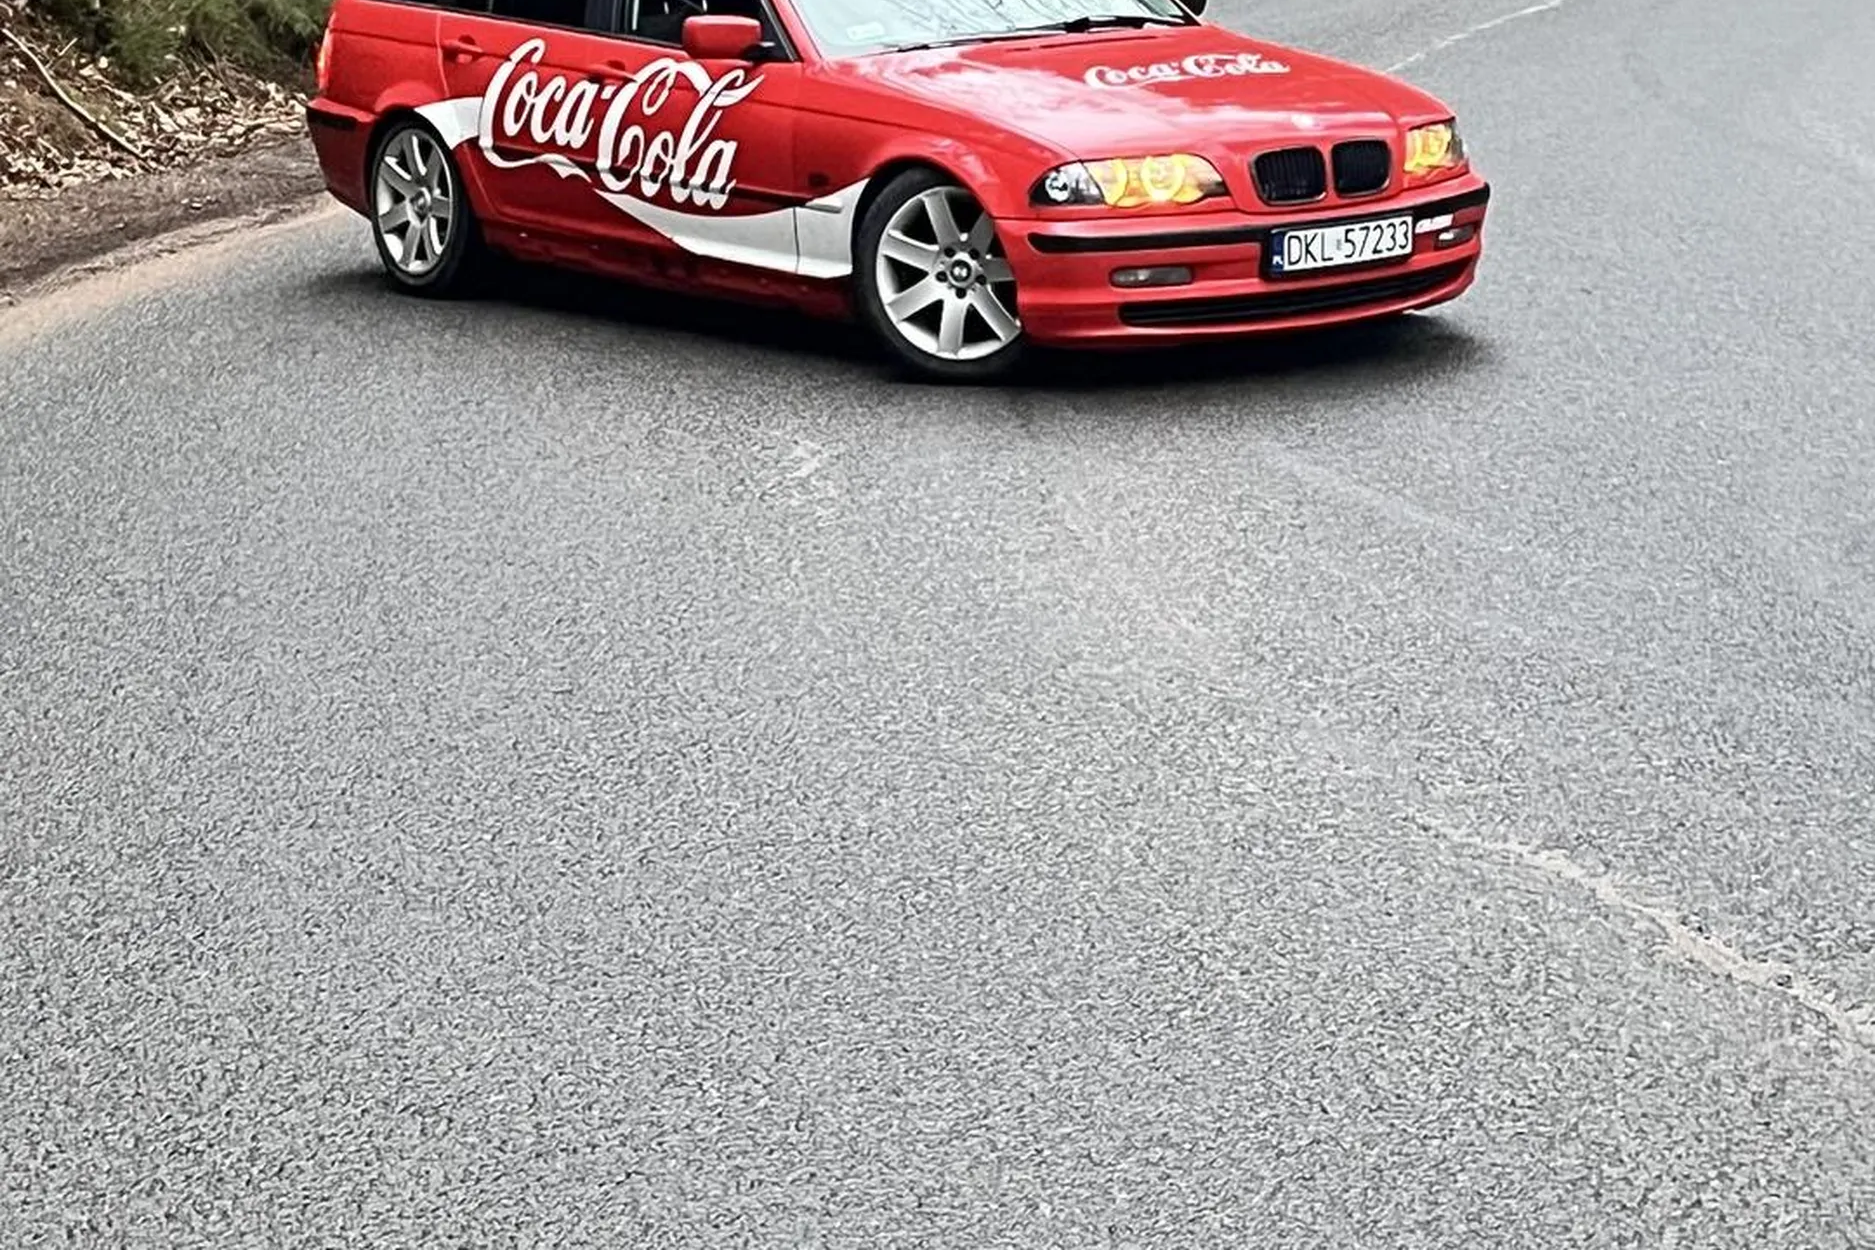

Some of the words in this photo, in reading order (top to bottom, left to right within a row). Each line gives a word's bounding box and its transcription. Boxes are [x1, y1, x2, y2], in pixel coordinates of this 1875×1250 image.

[479, 38, 765, 210] Coca-Cola
[1287, 231, 1334, 266] DKL
[1344, 220, 1410, 259] 57233
